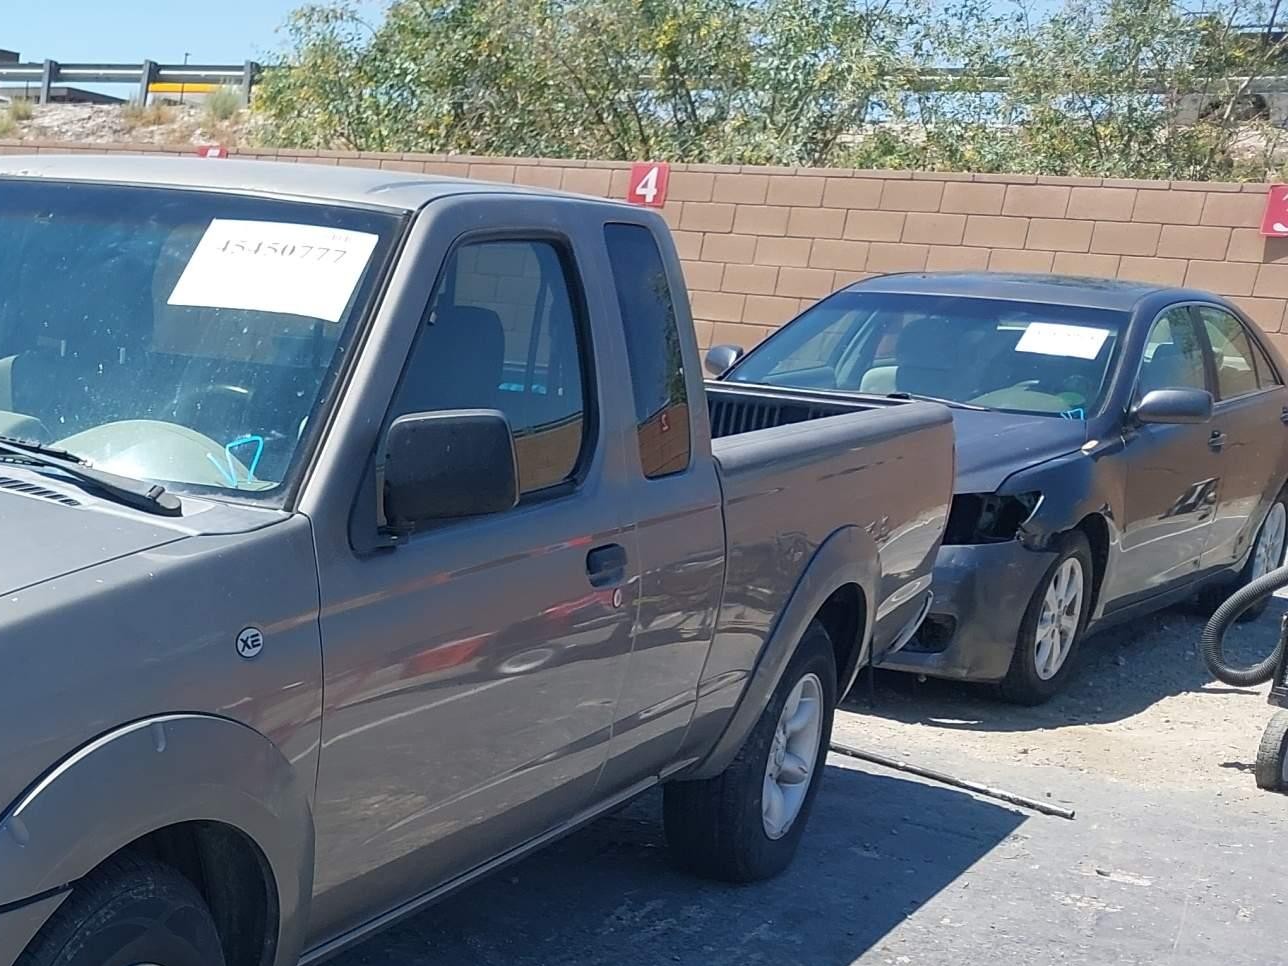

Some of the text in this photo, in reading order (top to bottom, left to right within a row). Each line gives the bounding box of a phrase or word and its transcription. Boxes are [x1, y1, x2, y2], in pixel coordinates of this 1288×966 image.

[635, 166, 659, 203] 4
[216, 239, 347, 263] 45450777
[240, 633, 261, 652] XE
